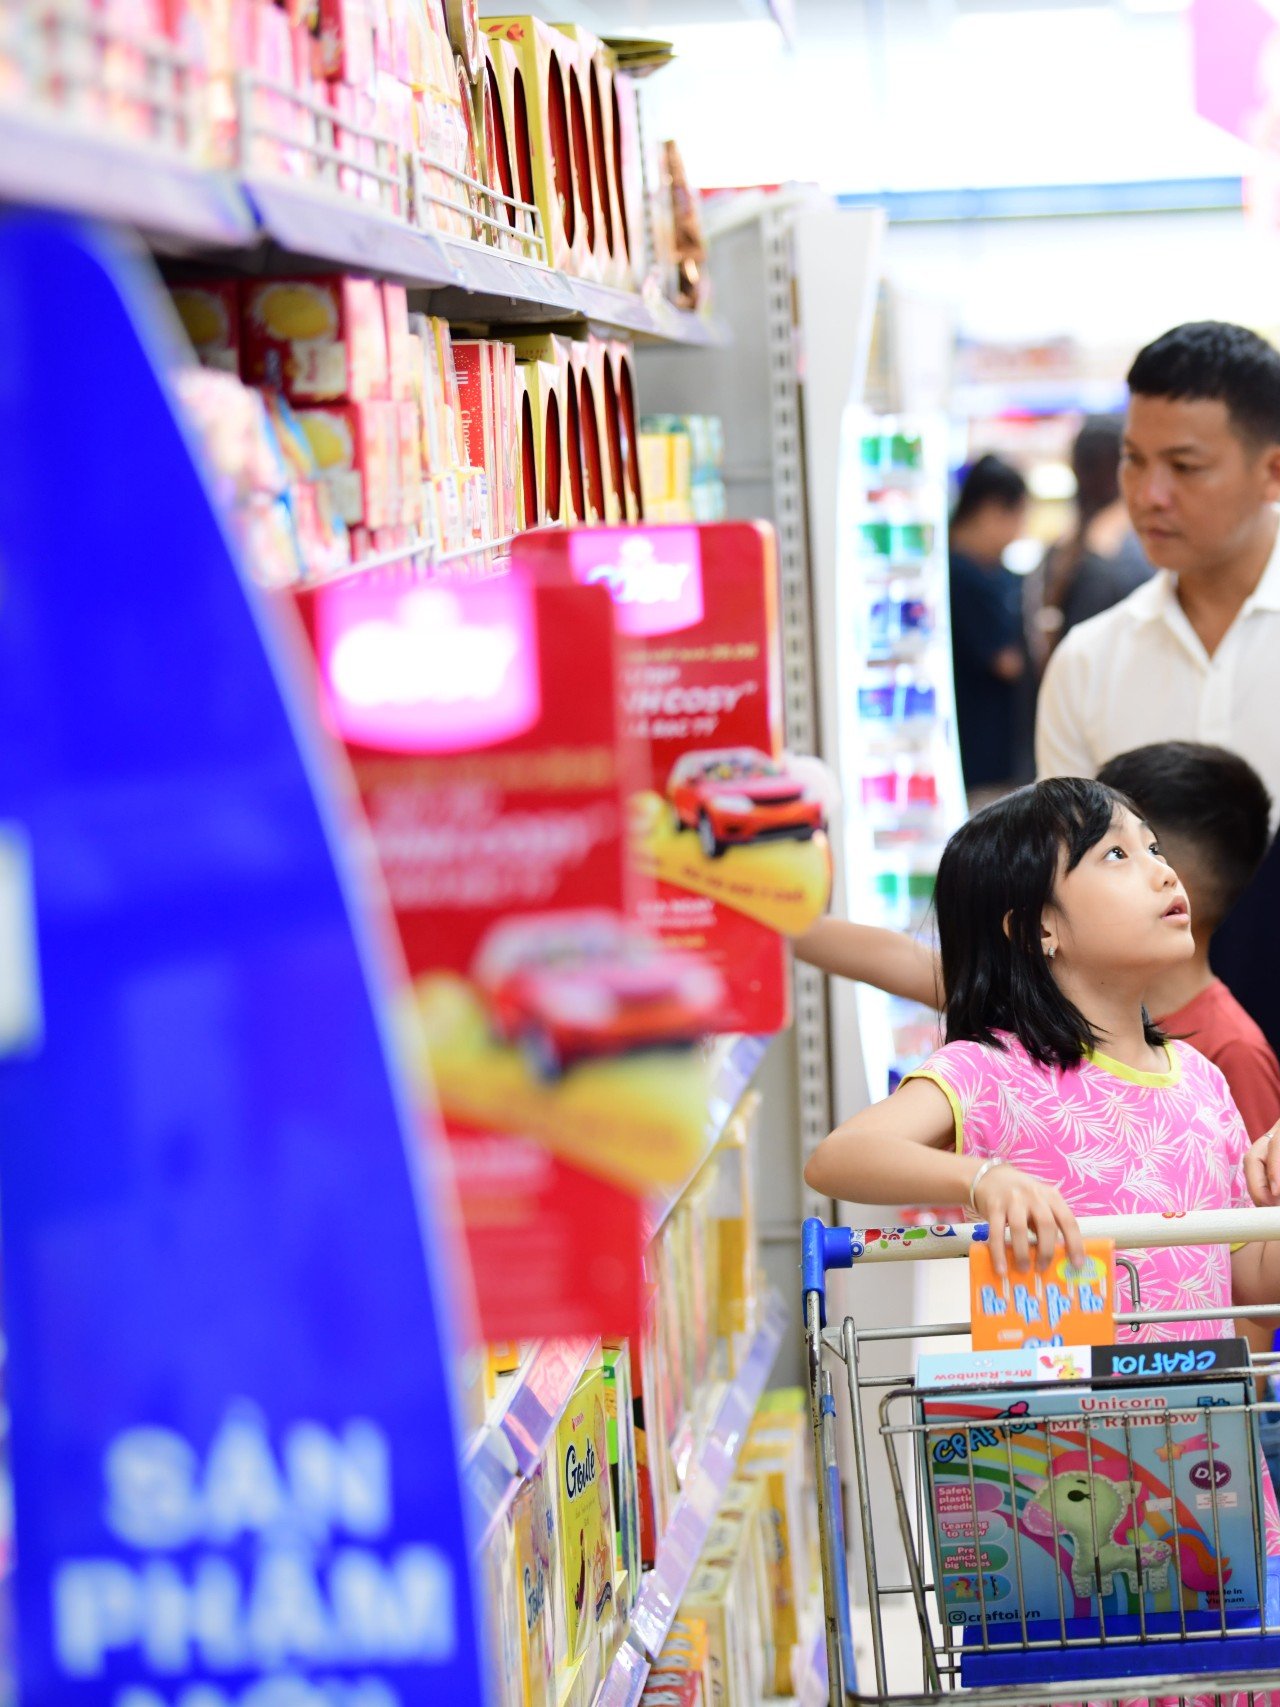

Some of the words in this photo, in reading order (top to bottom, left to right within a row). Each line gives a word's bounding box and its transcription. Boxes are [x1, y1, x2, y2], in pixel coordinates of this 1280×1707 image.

[1112, 1350, 1216, 1376] CRAFTOI
[1080, 1397, 1166, 1411] Unicorn
[1195, 1467, 1227, 1483] DY
[942, 1521, 988, 1530] Learnng
[947, 1530, 958, 1538] to
[946, 1553, 987, 1562] punchd
[944, 1561, 959, 1569] big
[965, 1560, 990, 1568] hoes
